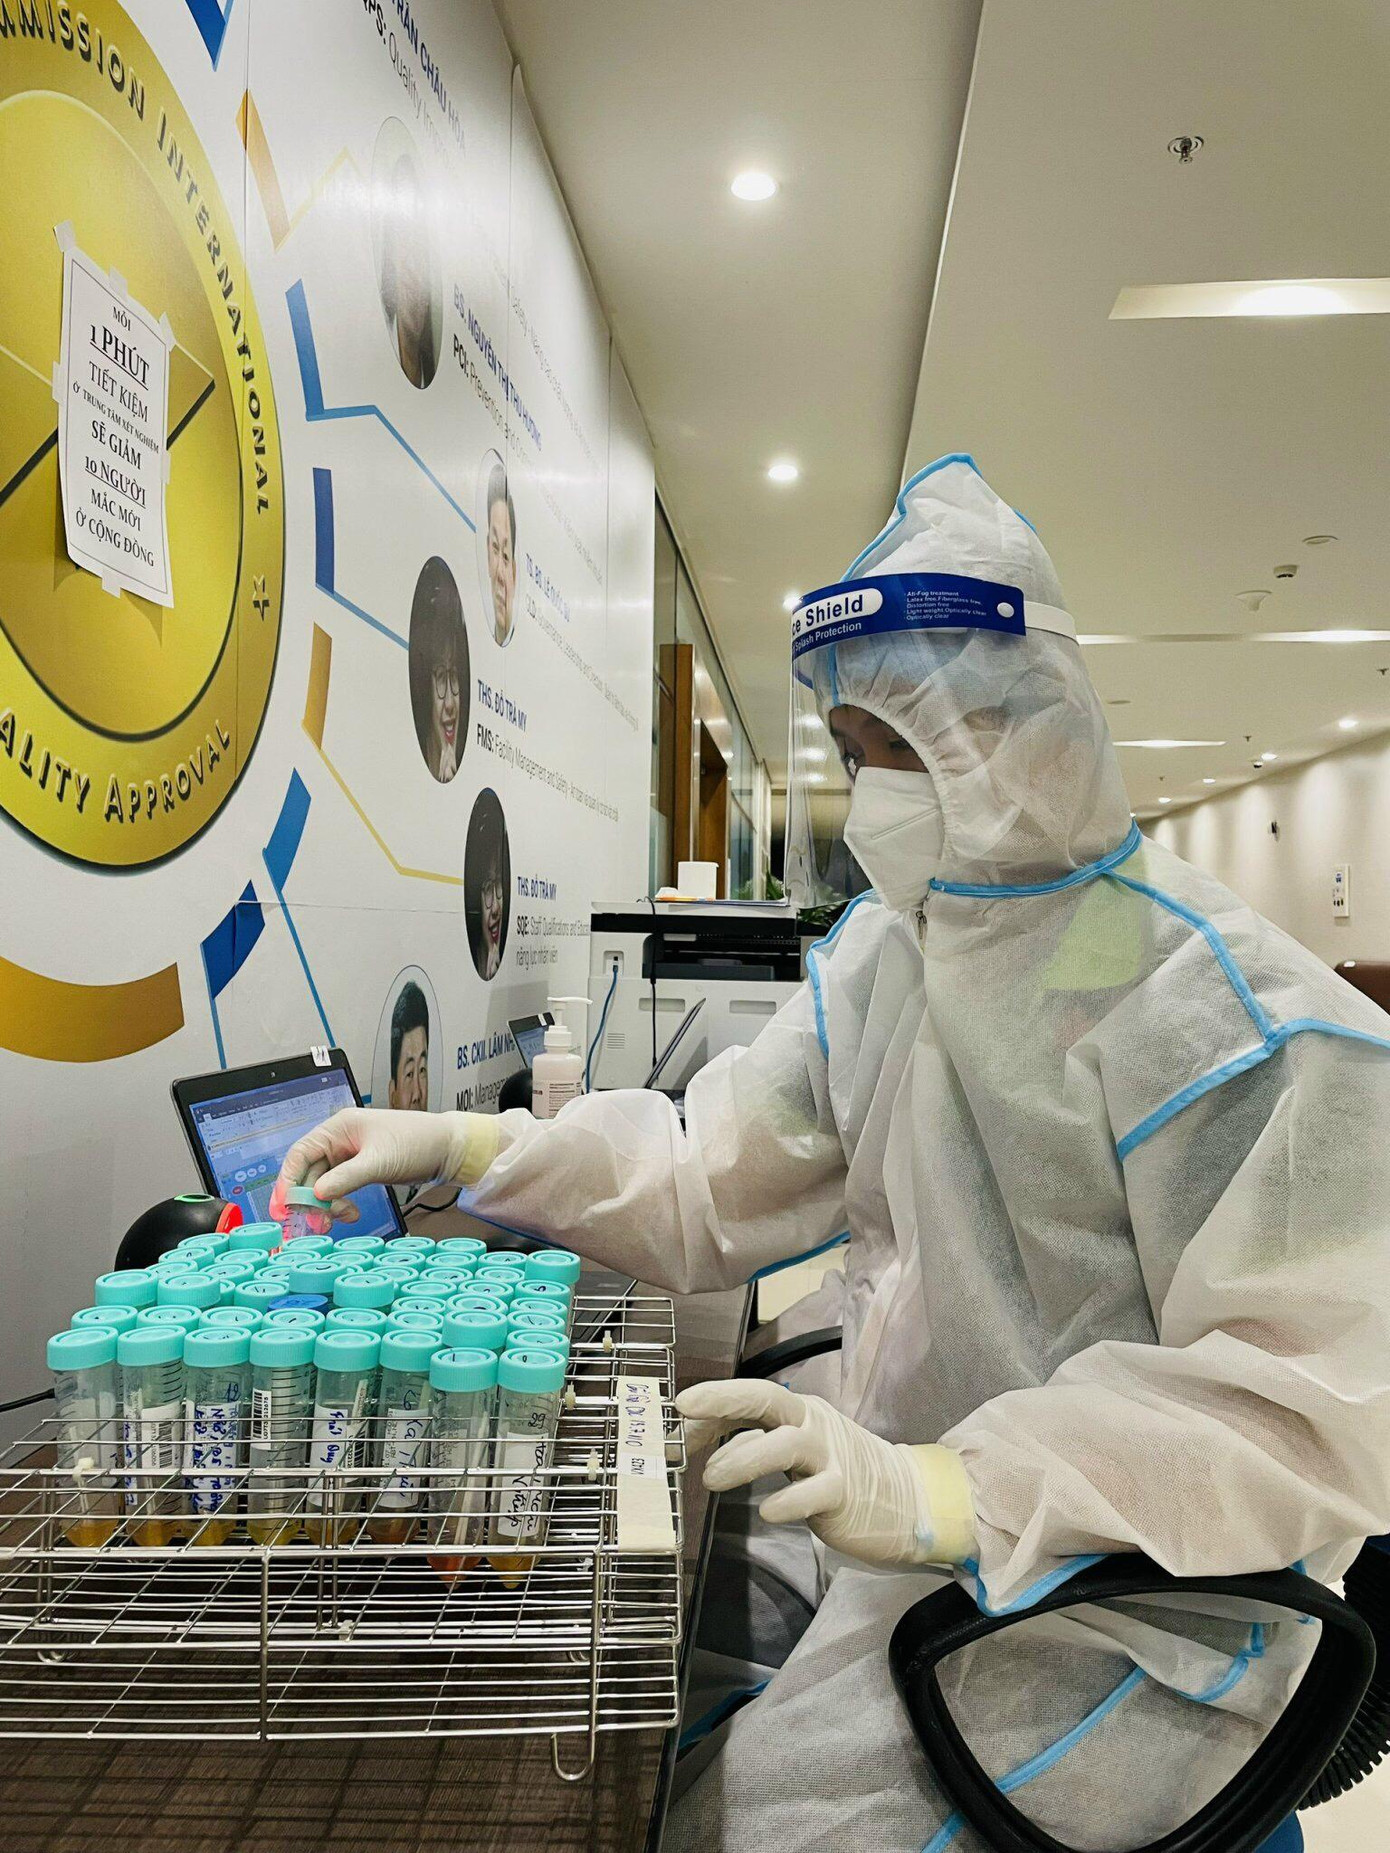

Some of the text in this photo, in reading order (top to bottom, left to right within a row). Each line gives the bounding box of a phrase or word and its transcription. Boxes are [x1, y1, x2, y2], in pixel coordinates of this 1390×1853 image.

[388, 31, 422, 120] Quality
[156, 106, 269, 515] INTERNATIONAL
[102, 325, 150, 385] PHÚT
[83, 388, 106, 415] TRUNG
[88, 360, 148, 422] TIẾT KIỆM
[109, 433, 141, 471] GIẢM
[85, 456, 146, 507] 10 NGƯỜI
[91, 488, 141, 532] MẮC MỚI
[88, 519, 120, 549] CỘNG
[123, 536, 154, 567] ĐỒNG
[806, 594, 863, 627] Shield
[815, 622, 862, 642] Protection
[477, 678, 494, 710] THS.
[505, 698, 517, 726] TRÀ
[476, 723, 494, 753] FMS:
[457, 1045, 470, 1070] BS.
[456, 1087, 474, 1112] MOI:
